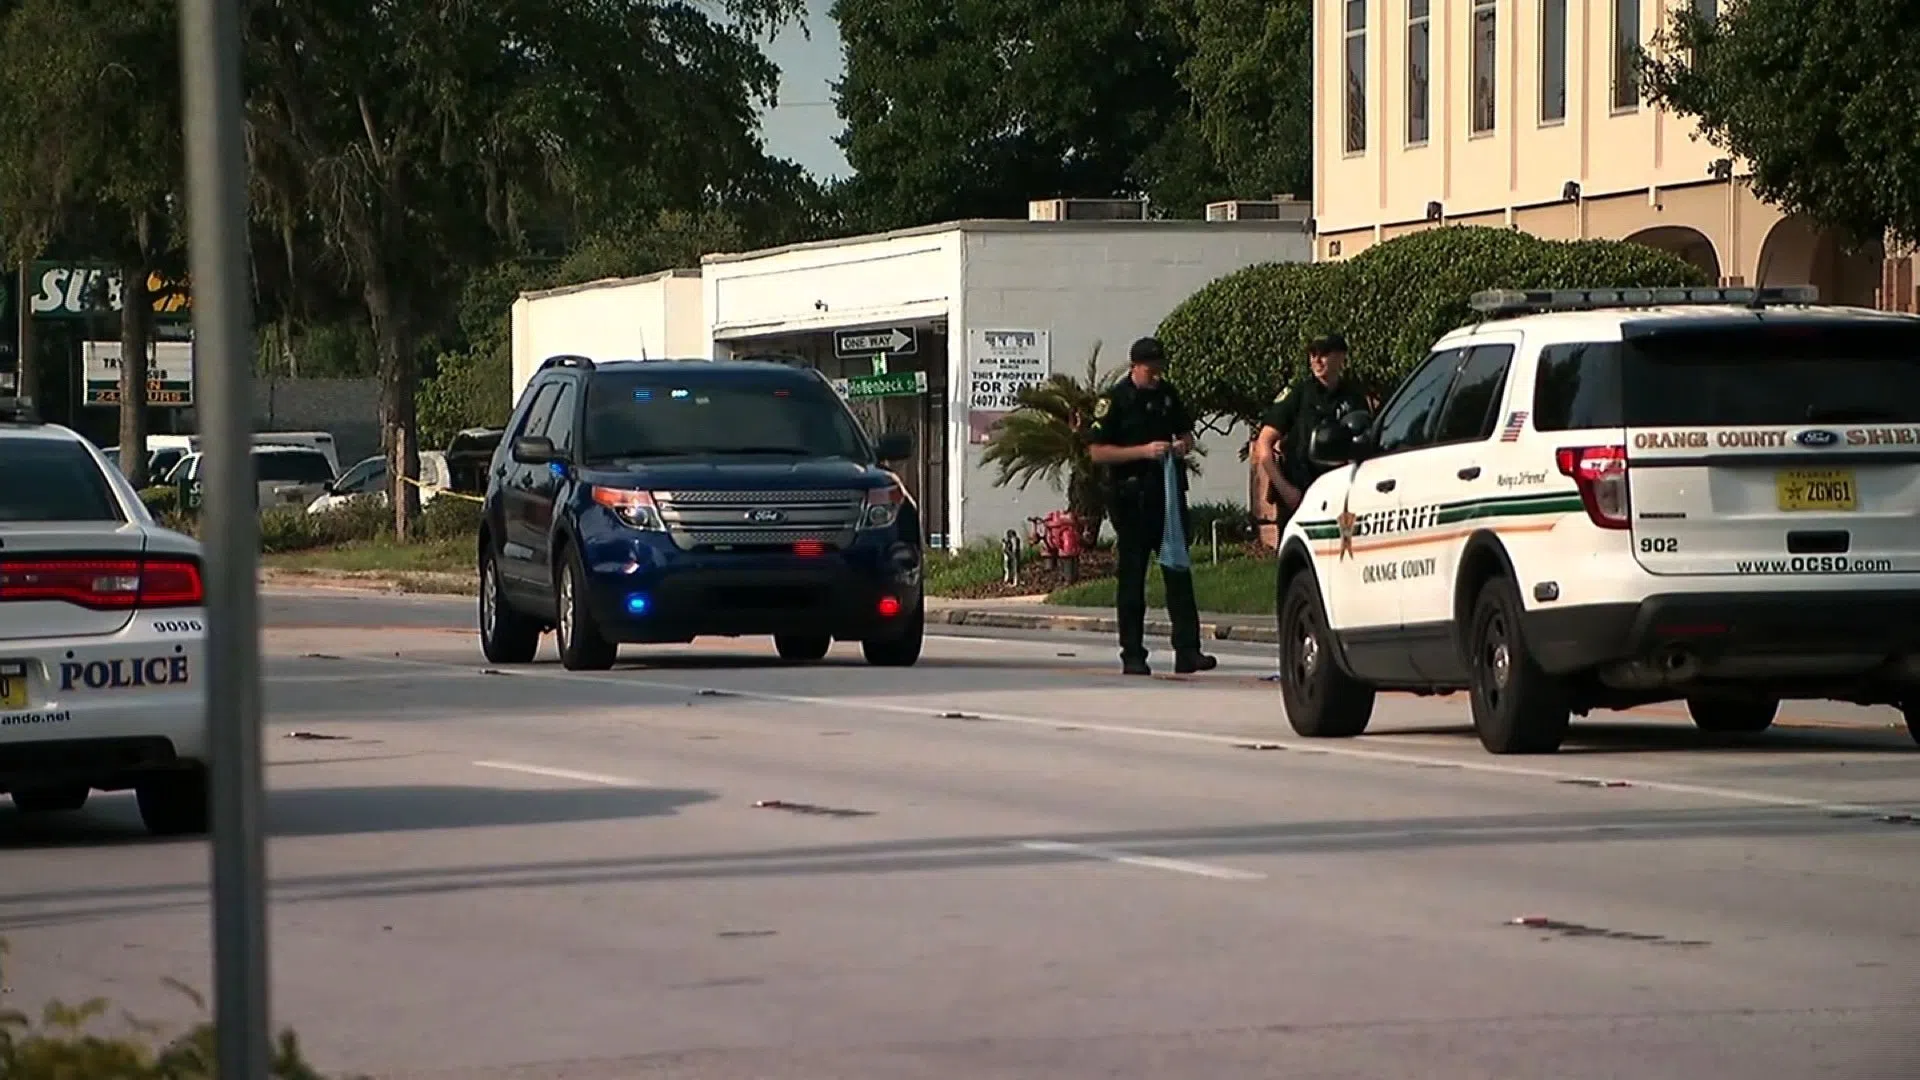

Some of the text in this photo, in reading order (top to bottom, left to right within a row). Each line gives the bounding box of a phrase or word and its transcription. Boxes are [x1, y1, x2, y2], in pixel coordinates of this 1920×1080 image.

[844, 336, 892, 349] ONE WAY
[972, 372, 1045, 381] THIS PROPERTY
[972, 381, 1001, 393] FOR
[972, 394, 997, 408] (407)
[1635, 428, 1920, 448] ORANGE COUNTY SHE
[1359, 504, 1440, 536] SHERIFF
[1641, 538, 1678, 552] 902
[1363, 558, 1436, 583] ORANGE COUNTY
[1737, 557, 1891, 572] www.OCSO.com
[154, 620, 202, 633] 9096
[60, 656, 189, 690] POLICE
